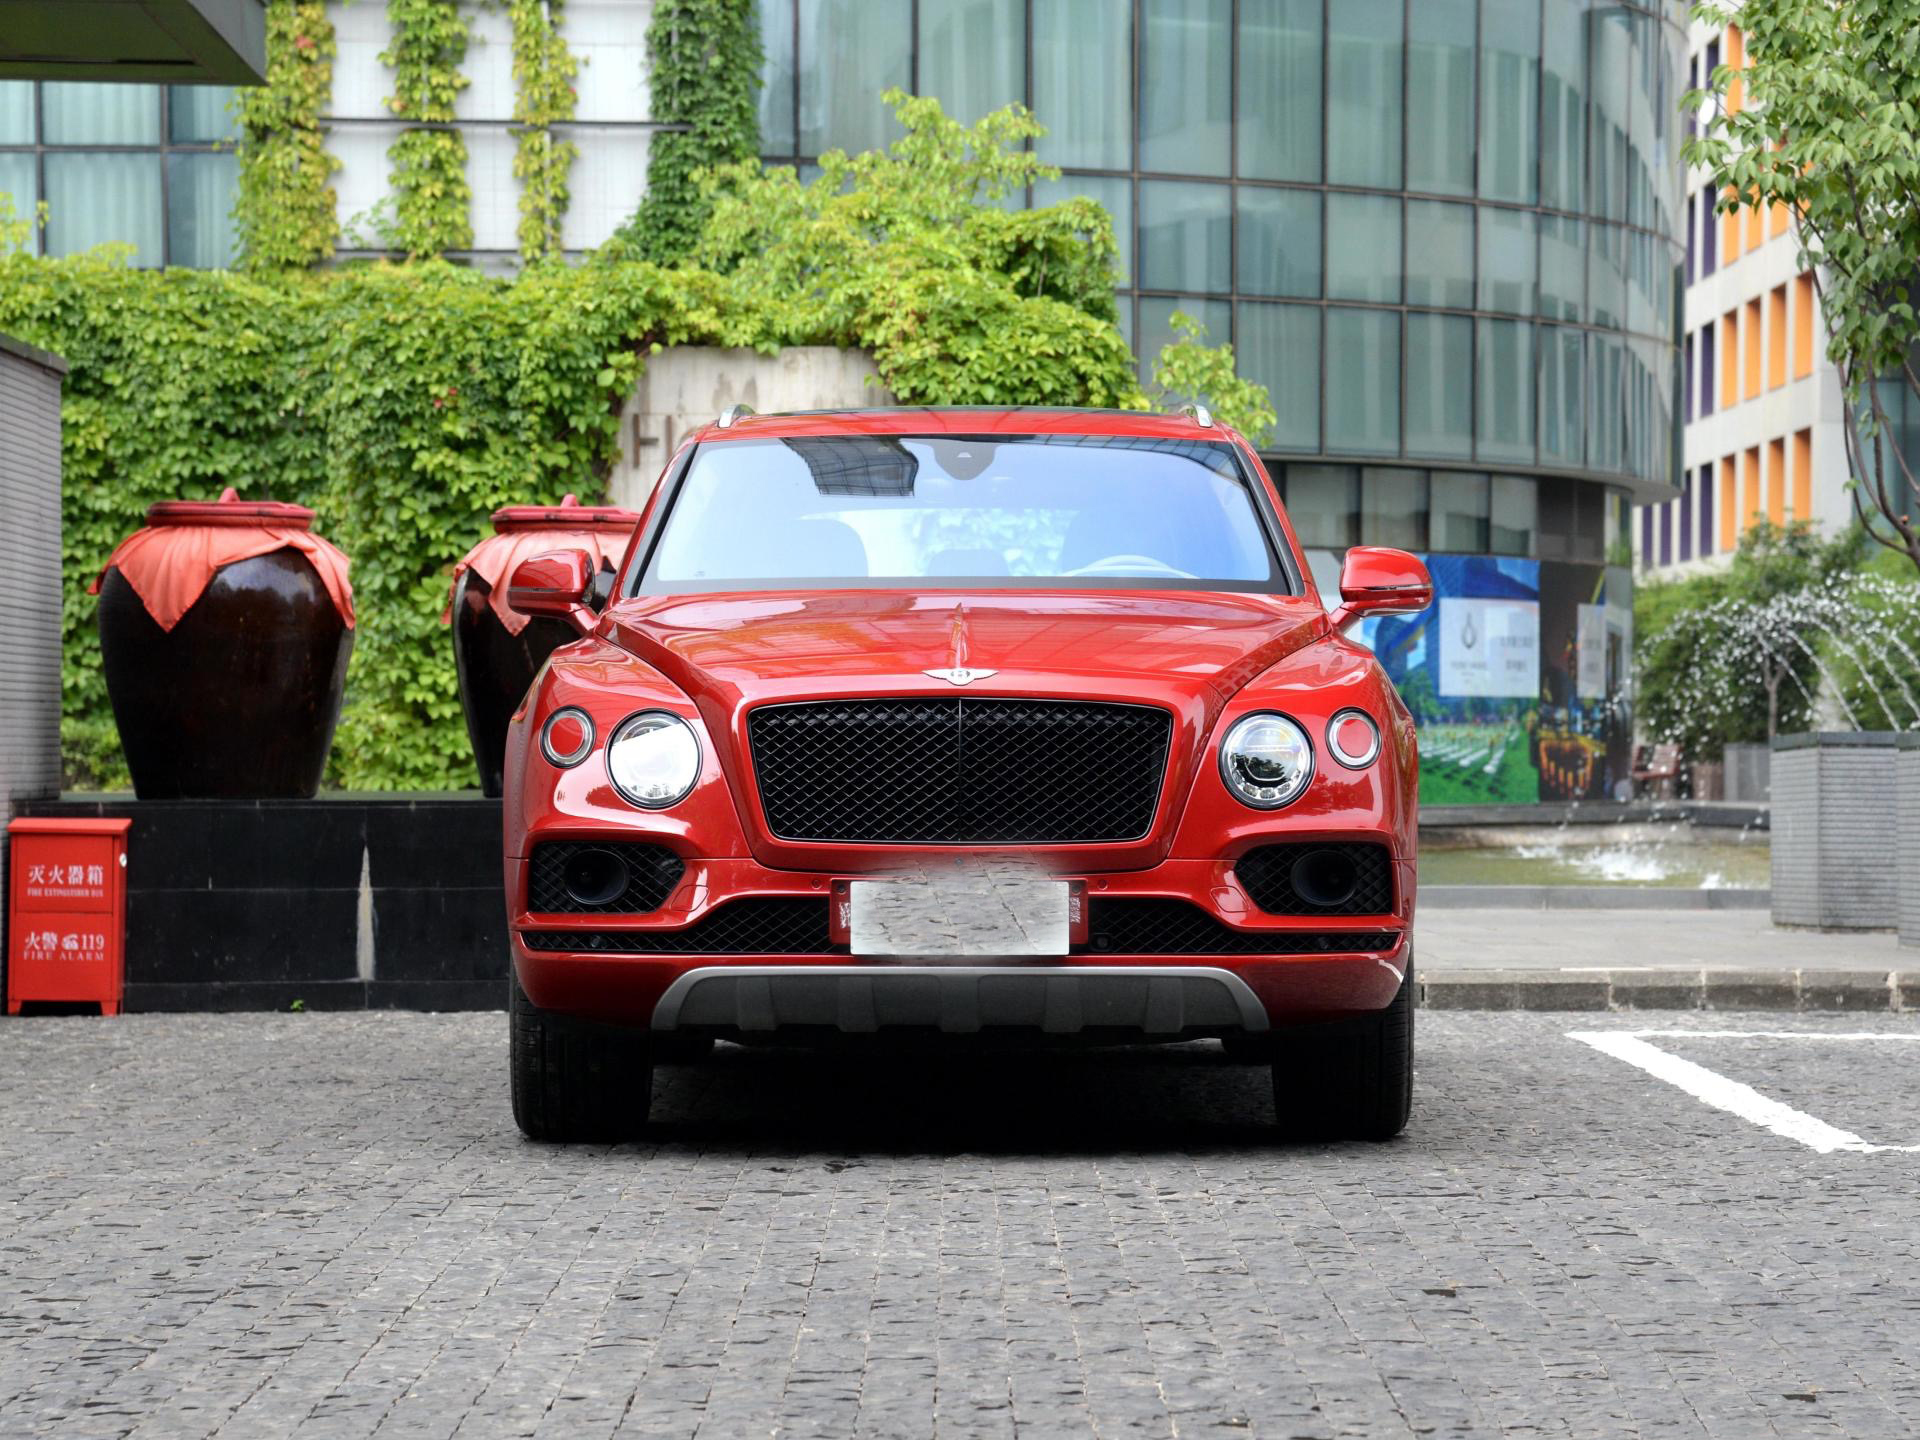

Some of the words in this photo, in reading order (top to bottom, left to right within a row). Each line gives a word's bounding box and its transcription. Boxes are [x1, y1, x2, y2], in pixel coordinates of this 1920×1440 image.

[28, 865, 104, 885] 灭火器箱
[25, 931, 58, 951] 火警
[82, 934, 104, 950] 119
[24, 951, 53, 960] FIRE
[60, 951, 104, 960] ALARM
